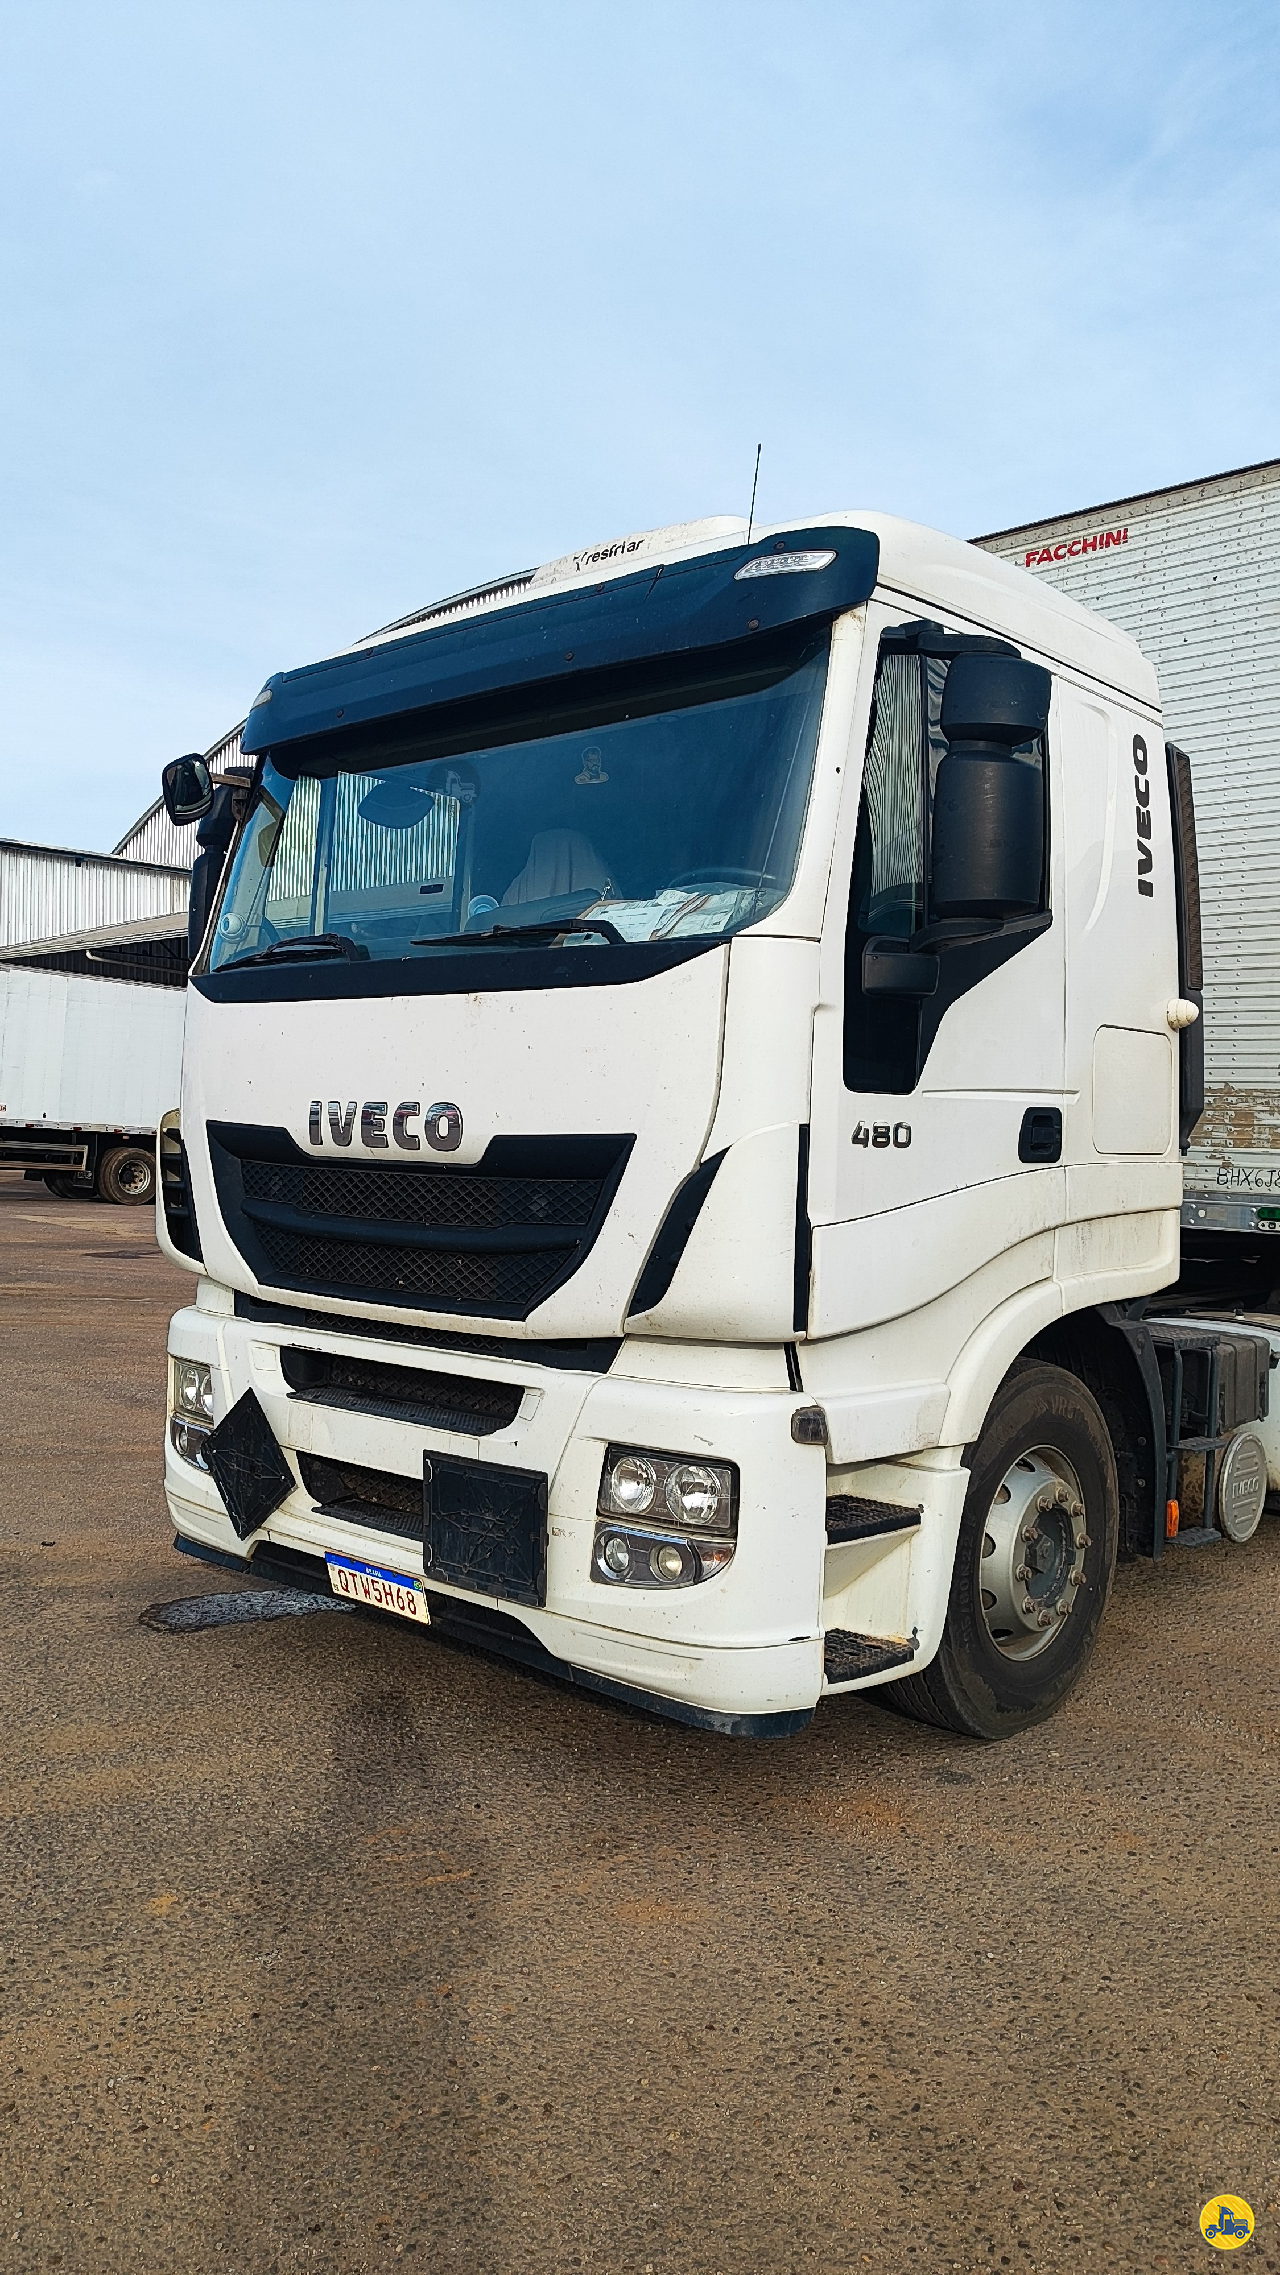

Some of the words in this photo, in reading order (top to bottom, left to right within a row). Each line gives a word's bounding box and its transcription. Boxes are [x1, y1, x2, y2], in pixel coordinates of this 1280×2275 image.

[1025, 527, 1129, 567] FACCHINI
[1132, 733, 1154, 898] IVECO
[308, 1101, 464, 1152] IVECO
[851, 1120, 912, 1149] 480
[1232, 1476, 1259, 1499] IVECO
[338, 1569, 417, 1615] QTW5H68
